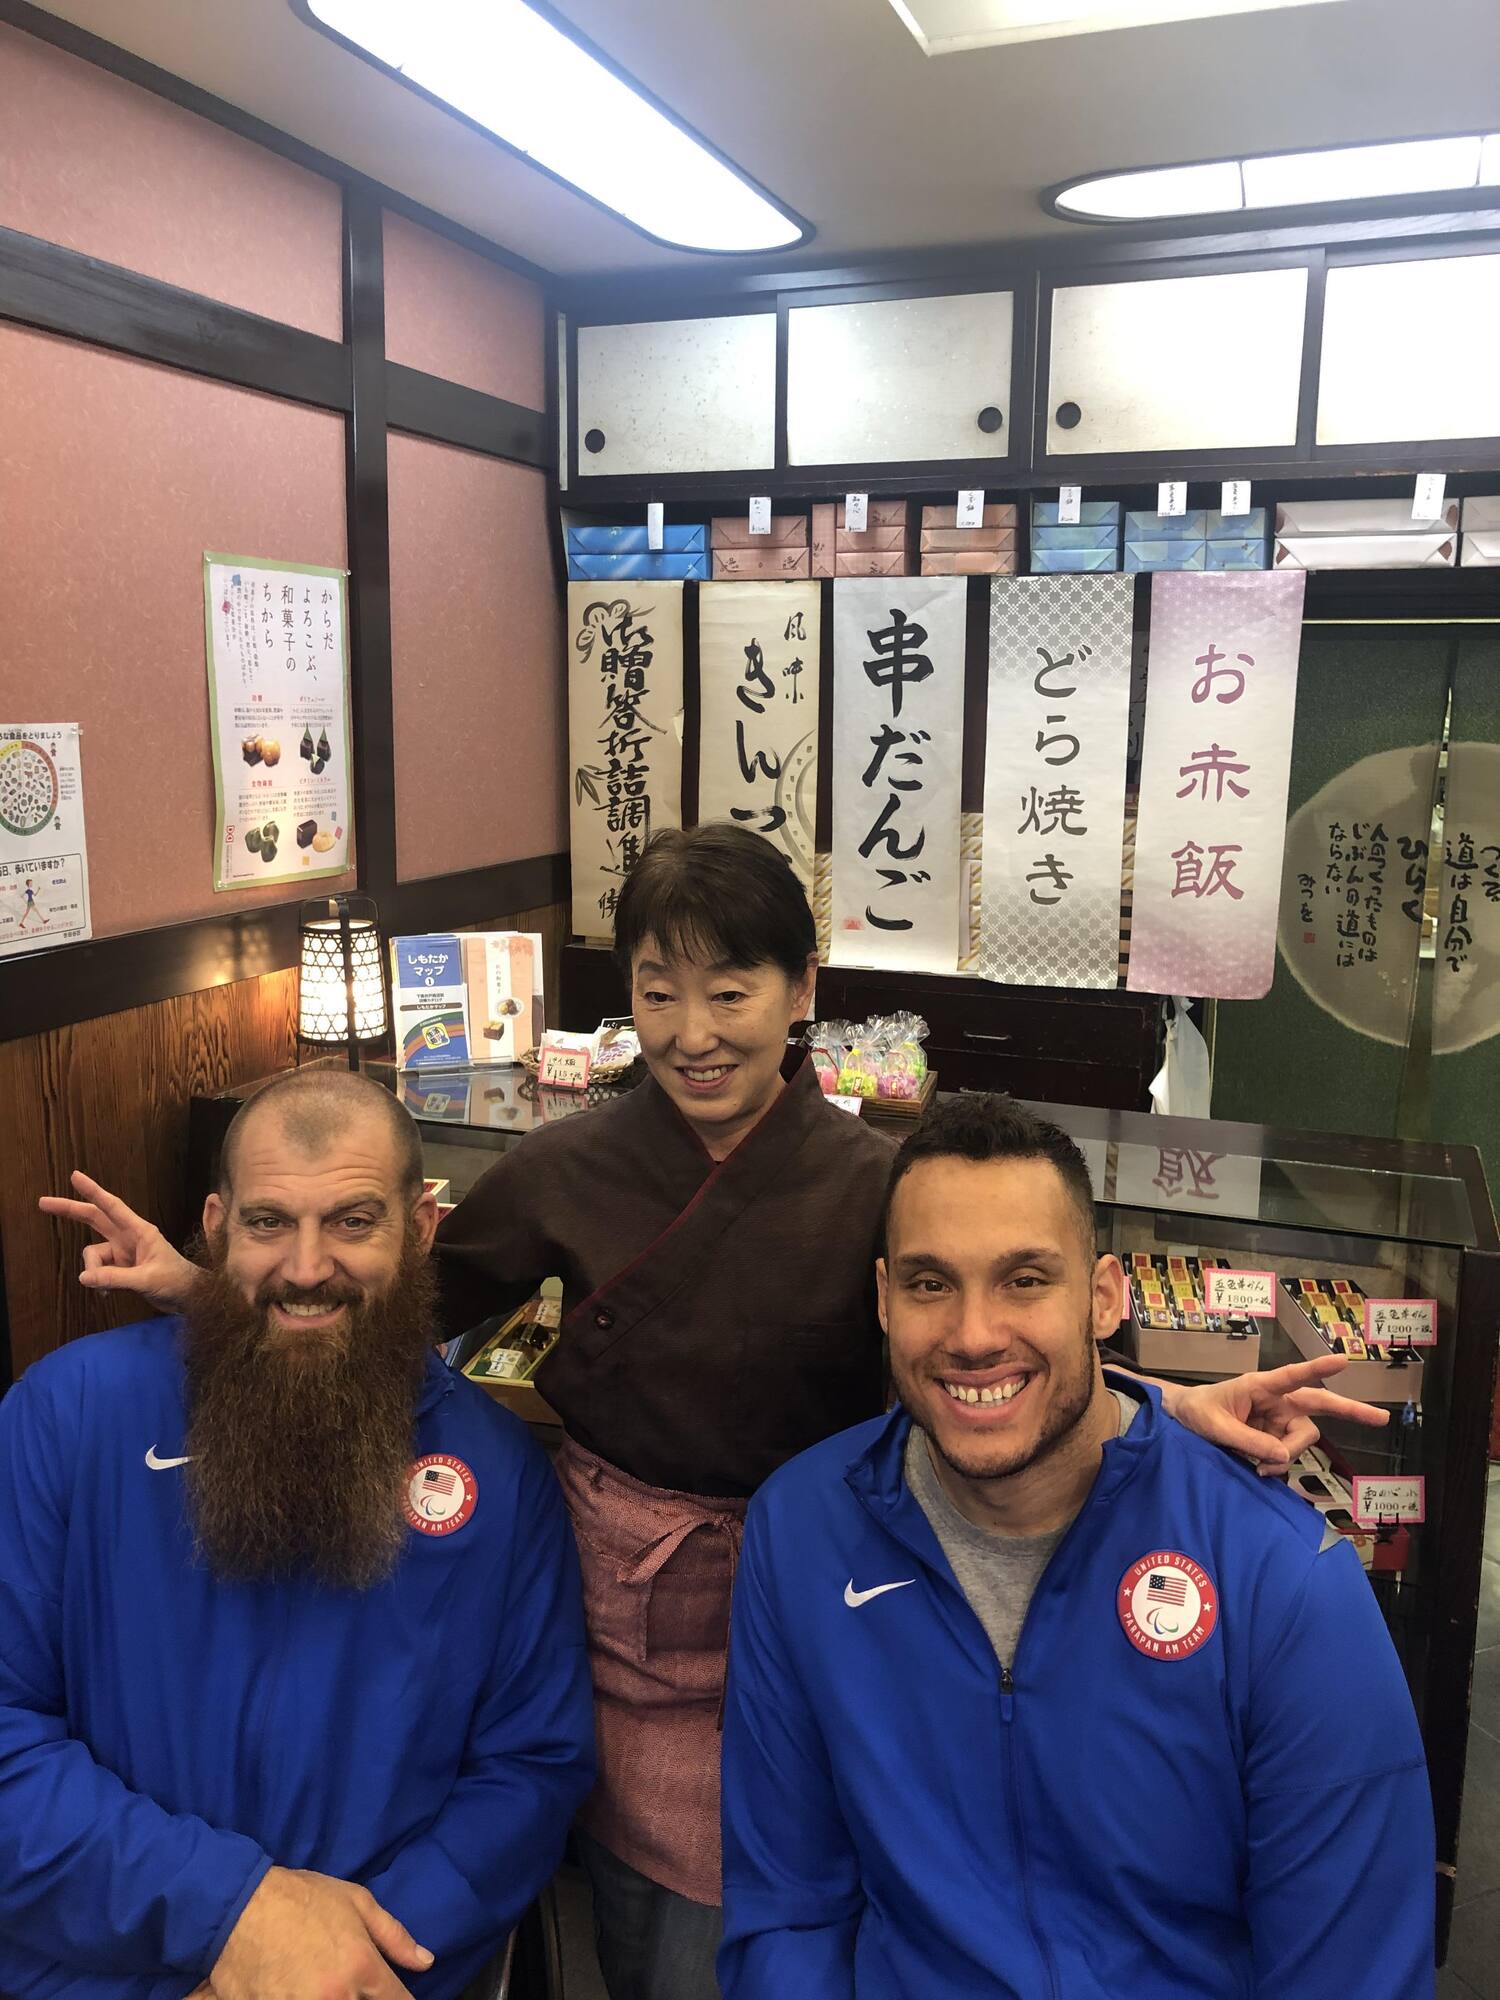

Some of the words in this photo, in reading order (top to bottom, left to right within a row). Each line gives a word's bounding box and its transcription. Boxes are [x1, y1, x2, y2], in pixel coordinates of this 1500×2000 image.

[261, 582, 274, 648] ちから
[281, 585, 296, 672] 和菓子の
[303, 587, 318, 681] よろこぶ、
[321, 589, 334, 651] からだ
[782, 611, 807, 704] 風味
[730, 637, 788, 834] きんつ
[858, 608, 935, 931] 串だんご
[1016, 643, 1093, 906] どら焼き
[1170, 643, 1255, 900] お赤飯
[1298, 873, 1317, 923] みつを
[1325, 821, 1348, 895] ならない
[1336, 822, 1371, 968] じぶんの道には
[1358, 823, 1390, 962] 人のつくったものは
[1444, 832, 1479, 973] 道は自分で
[408, 953, 449, 965] しもたか
[414, 965, 445, 976] マップ
[413, 1456, 444, 1471] UNITED
[446, 1458, 472, 1483] STATES
[431, 1523, 443, 1532] AM
[446, 1511, 465, 1529] TEAM
[1134, 1555, 1170, 1576] UNITED
[1174, 1556, 1207, 1588] STATES
[1123, 1612, 1159, 1653] PARAPAN
[1165, 1643, 1180, 1655] AM
[1183, 1626, 1205, 1650] TEAM
